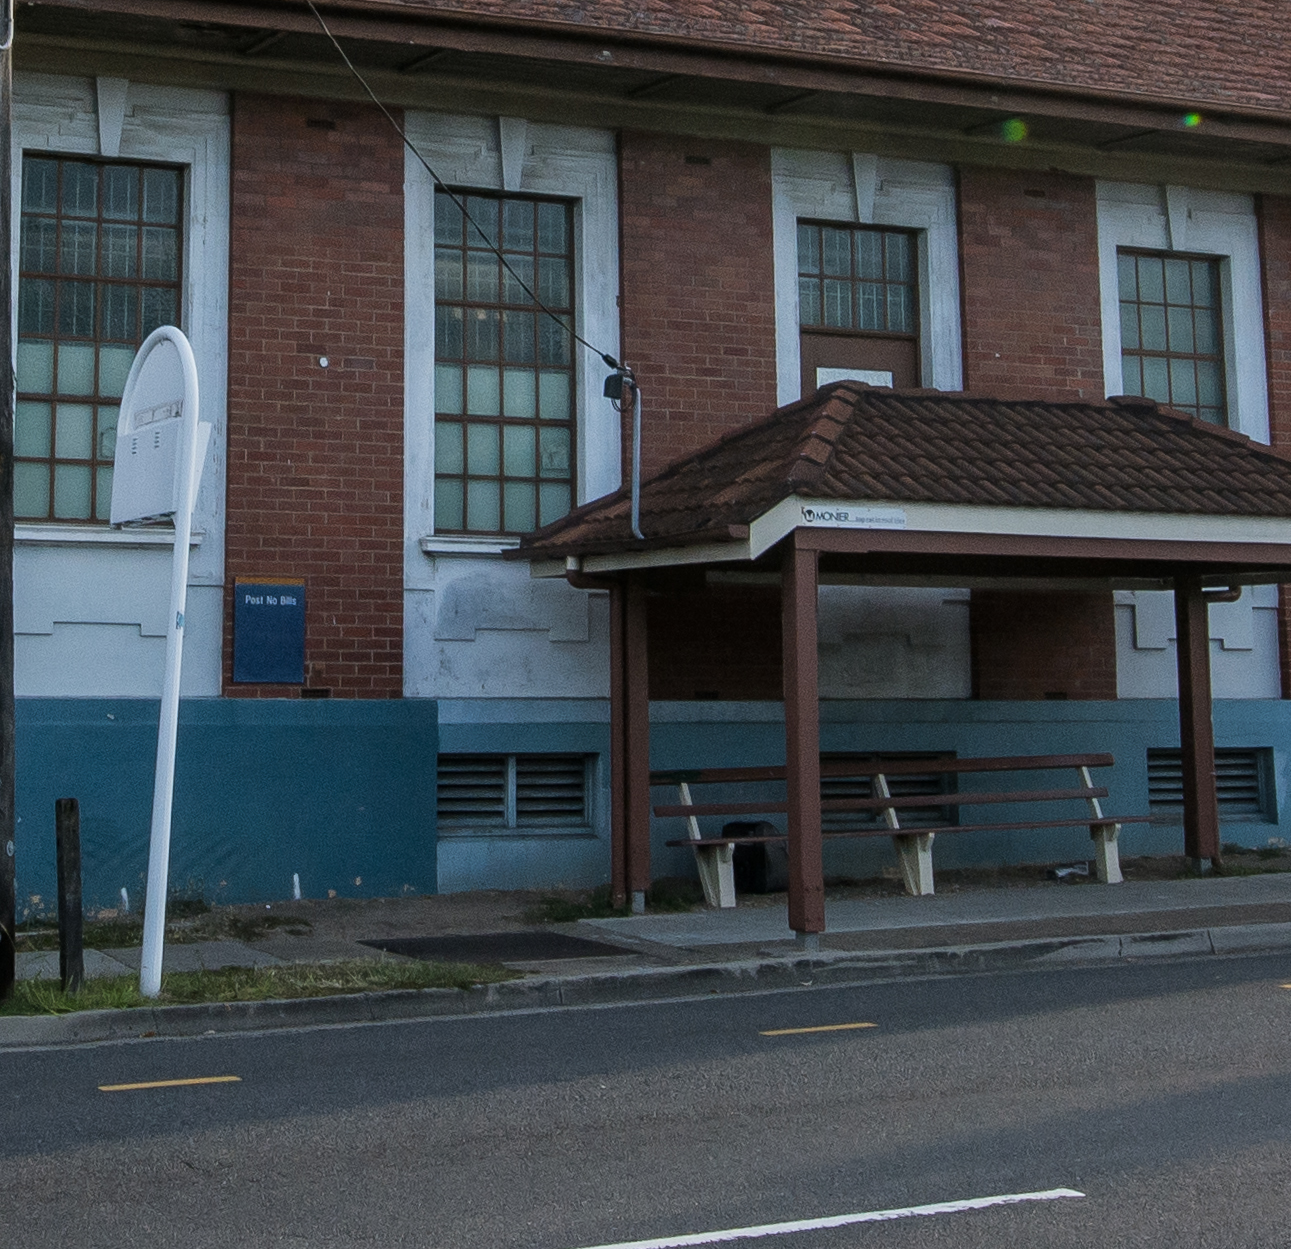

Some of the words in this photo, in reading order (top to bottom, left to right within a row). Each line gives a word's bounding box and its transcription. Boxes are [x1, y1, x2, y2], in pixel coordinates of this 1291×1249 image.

[815, 511, 850, 522] MONIER
[245, 595, 264, 605] Post
[266, 595, 278, 605] No
[280, 595, 297, 606] Bills
